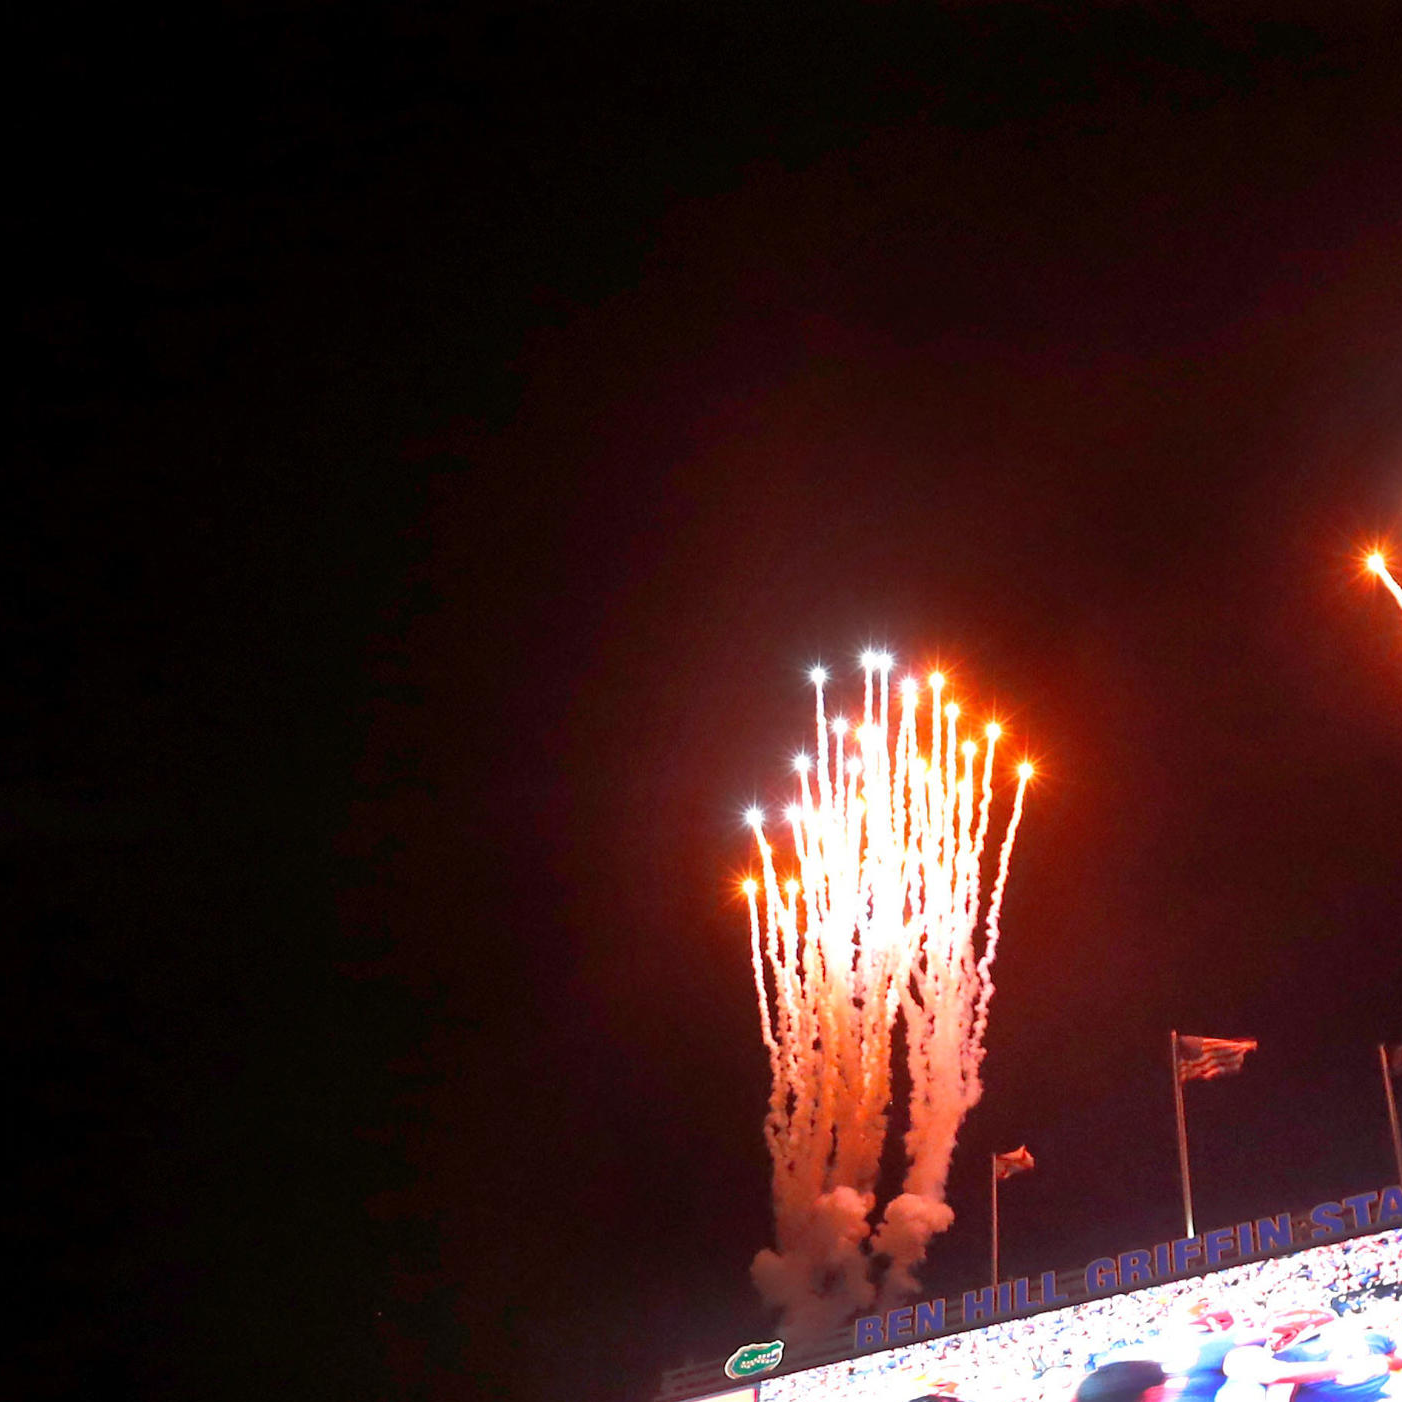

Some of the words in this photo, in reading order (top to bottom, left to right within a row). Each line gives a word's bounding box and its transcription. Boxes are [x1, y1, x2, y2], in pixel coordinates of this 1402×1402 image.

[854, 1298, 946, 1350] BEN
[963, 1270, 1069, 1325] HILL
[1084, 1211, 1298, 1297] GRIFFIN
